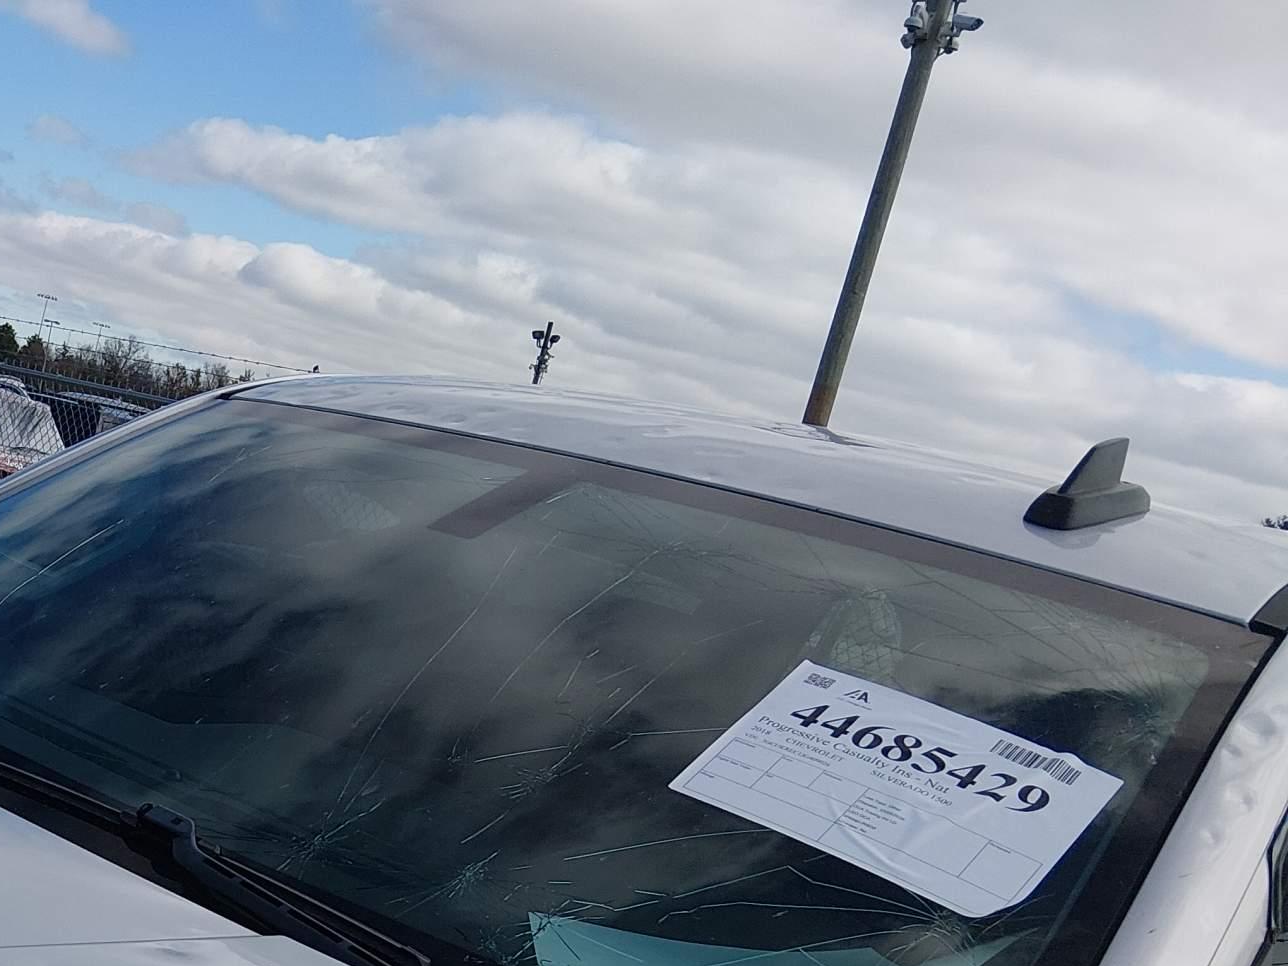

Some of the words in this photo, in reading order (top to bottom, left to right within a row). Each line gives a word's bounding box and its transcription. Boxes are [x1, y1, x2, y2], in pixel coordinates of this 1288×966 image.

[750, 724, 772, 736] 2018
[785, 737, 845, 762] CHEVROLET
[870, 769, 930, 797] SILVERADO
[931, 794, 953, 807] 1500
[757, 715, 831, 746] Progressive
[833, 743, 890, 769] Casualty
[891, 765, 913, 779] Ins
[924, 778, 951, 794] Nat
[790, 704, 1050, 812] 44685429
